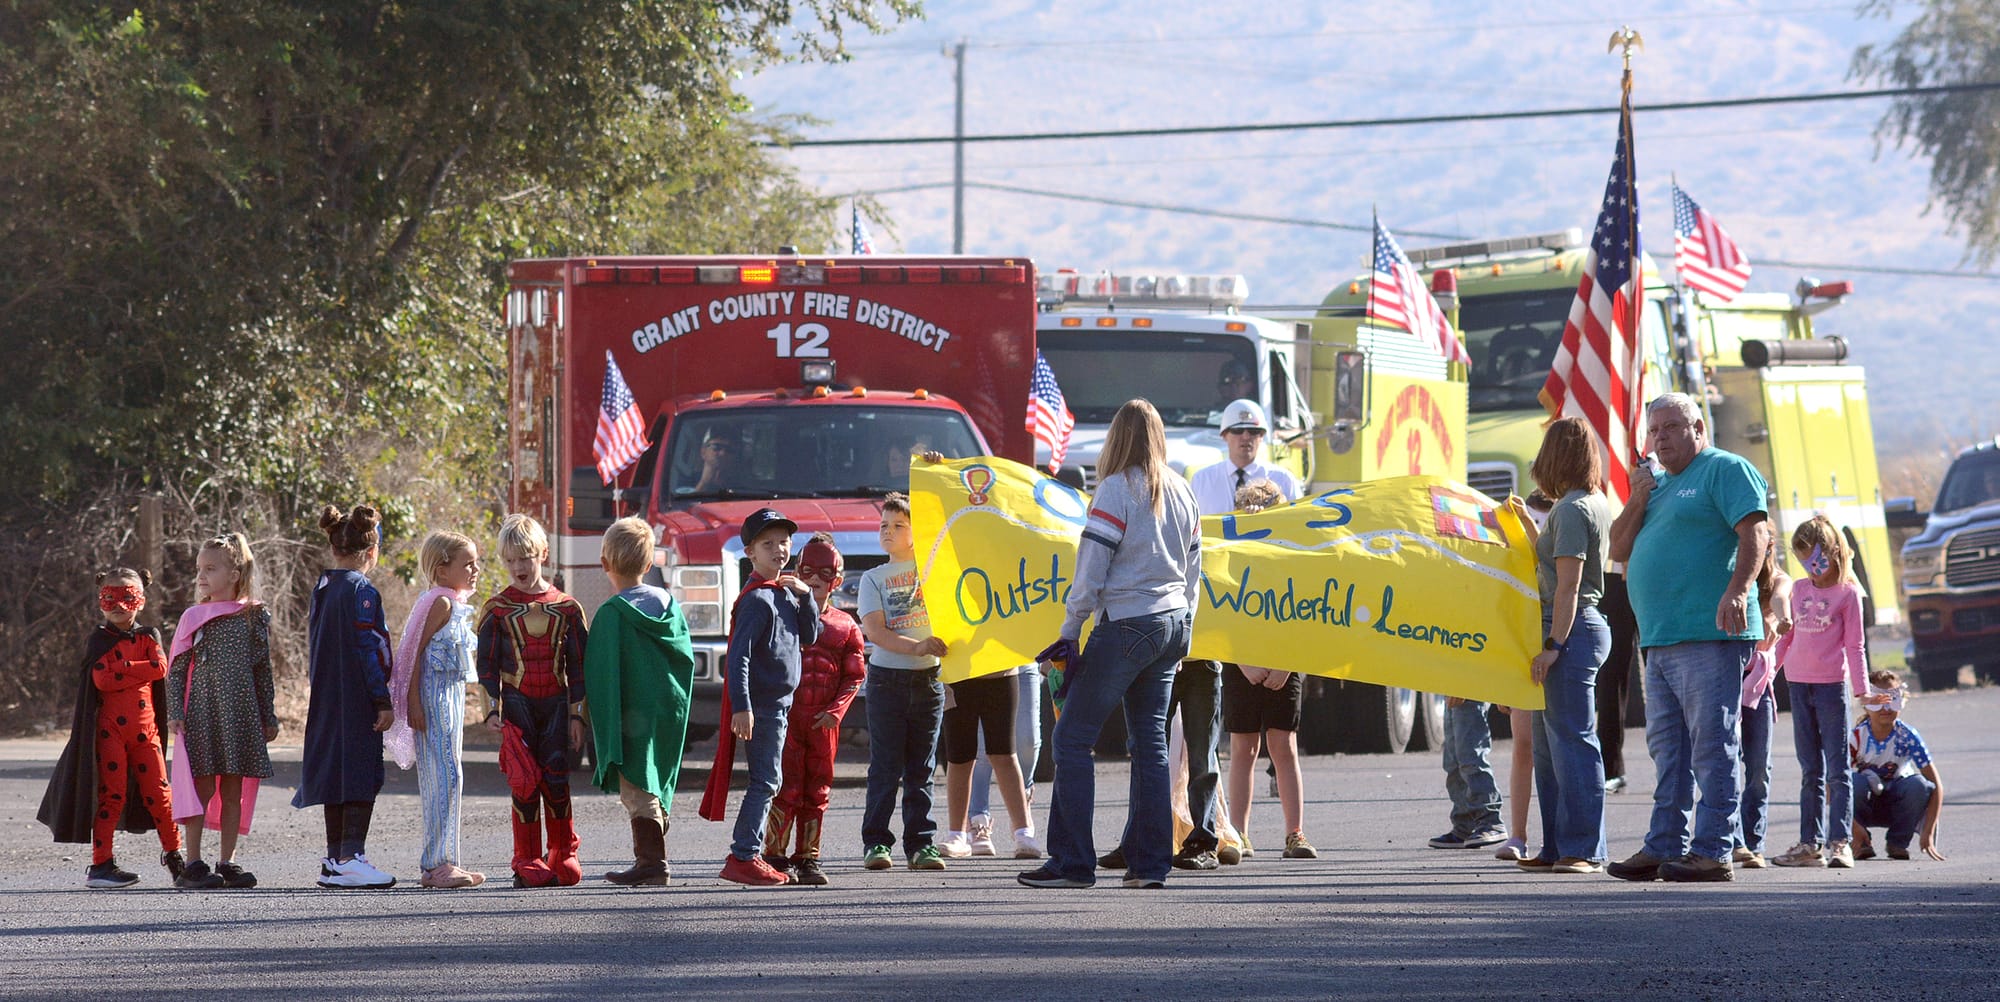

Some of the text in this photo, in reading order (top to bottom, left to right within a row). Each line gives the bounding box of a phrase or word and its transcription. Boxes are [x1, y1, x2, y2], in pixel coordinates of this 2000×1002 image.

[631, 290, 950, 353] GRANT COUNTY FIRE DISTRICT
[767, 321, 830, 358] 12
[1200, 565, 1354, 628] Wonderful
[1371, 584, 1488, 652] Learners
